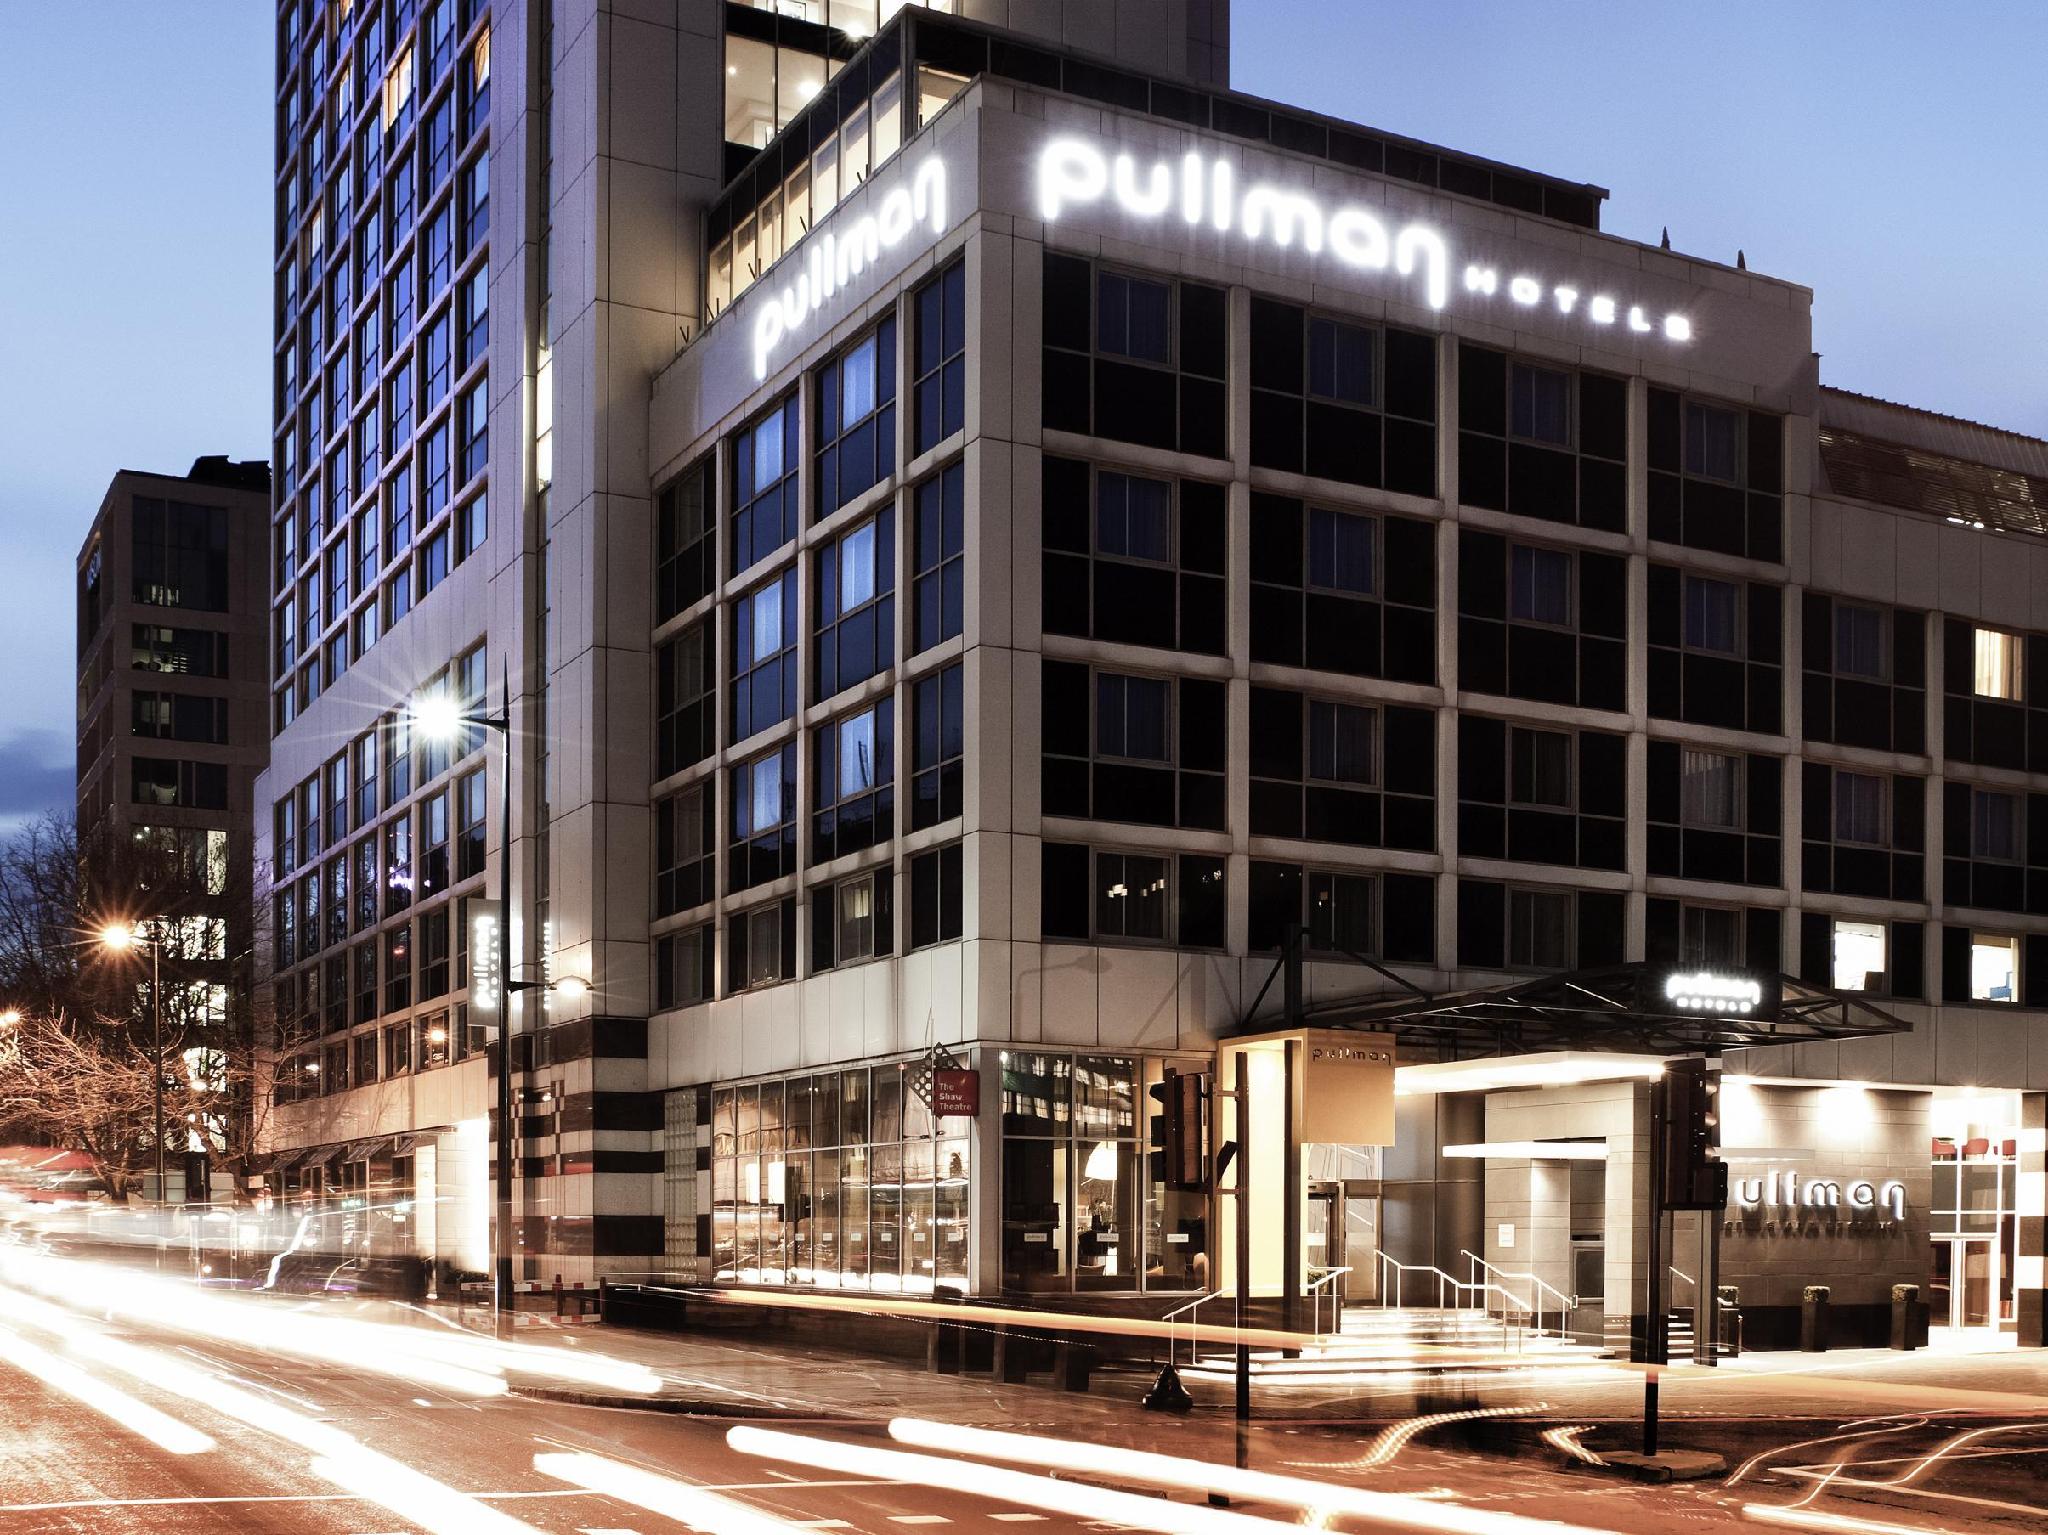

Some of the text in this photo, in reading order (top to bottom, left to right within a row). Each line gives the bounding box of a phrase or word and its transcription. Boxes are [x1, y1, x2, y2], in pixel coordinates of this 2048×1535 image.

[1040, 140, 1691, 342] pullman HOTELS
[753, 156, 947, 381] pullman
[1312, 1047, 1392, 1066] pullman
[939, 1083, 955, 1091] The
[939, 1093, 963, 1101] Shaw
[939, 1103, 972, 1111] Theatre
[1734, 1169, 1907, 1220] ullman
